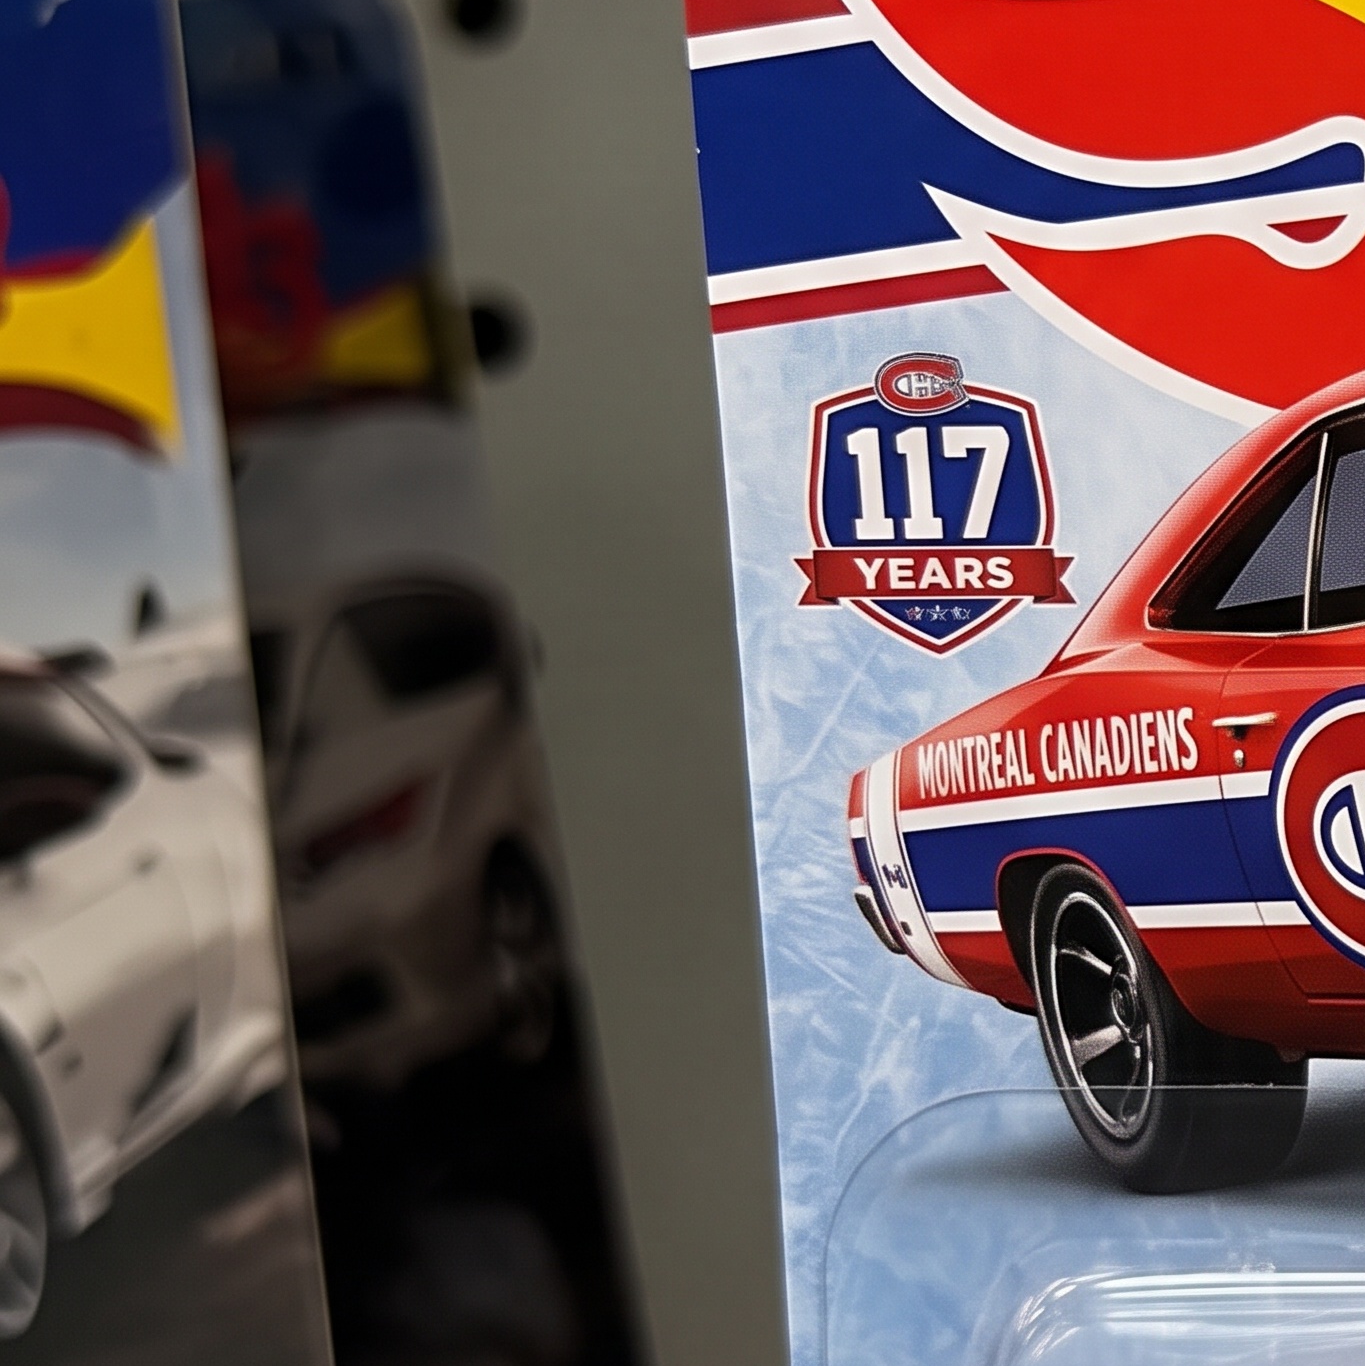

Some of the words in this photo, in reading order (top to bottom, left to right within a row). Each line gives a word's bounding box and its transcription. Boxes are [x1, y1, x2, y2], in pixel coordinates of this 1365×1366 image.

[847, 426, 1010, 540] 117
[853, 557, 1015, 590] YEARS
[917, 728, 1036, 800] MONTREAL
[1040, 706, 1198, 782] CANADIENS
